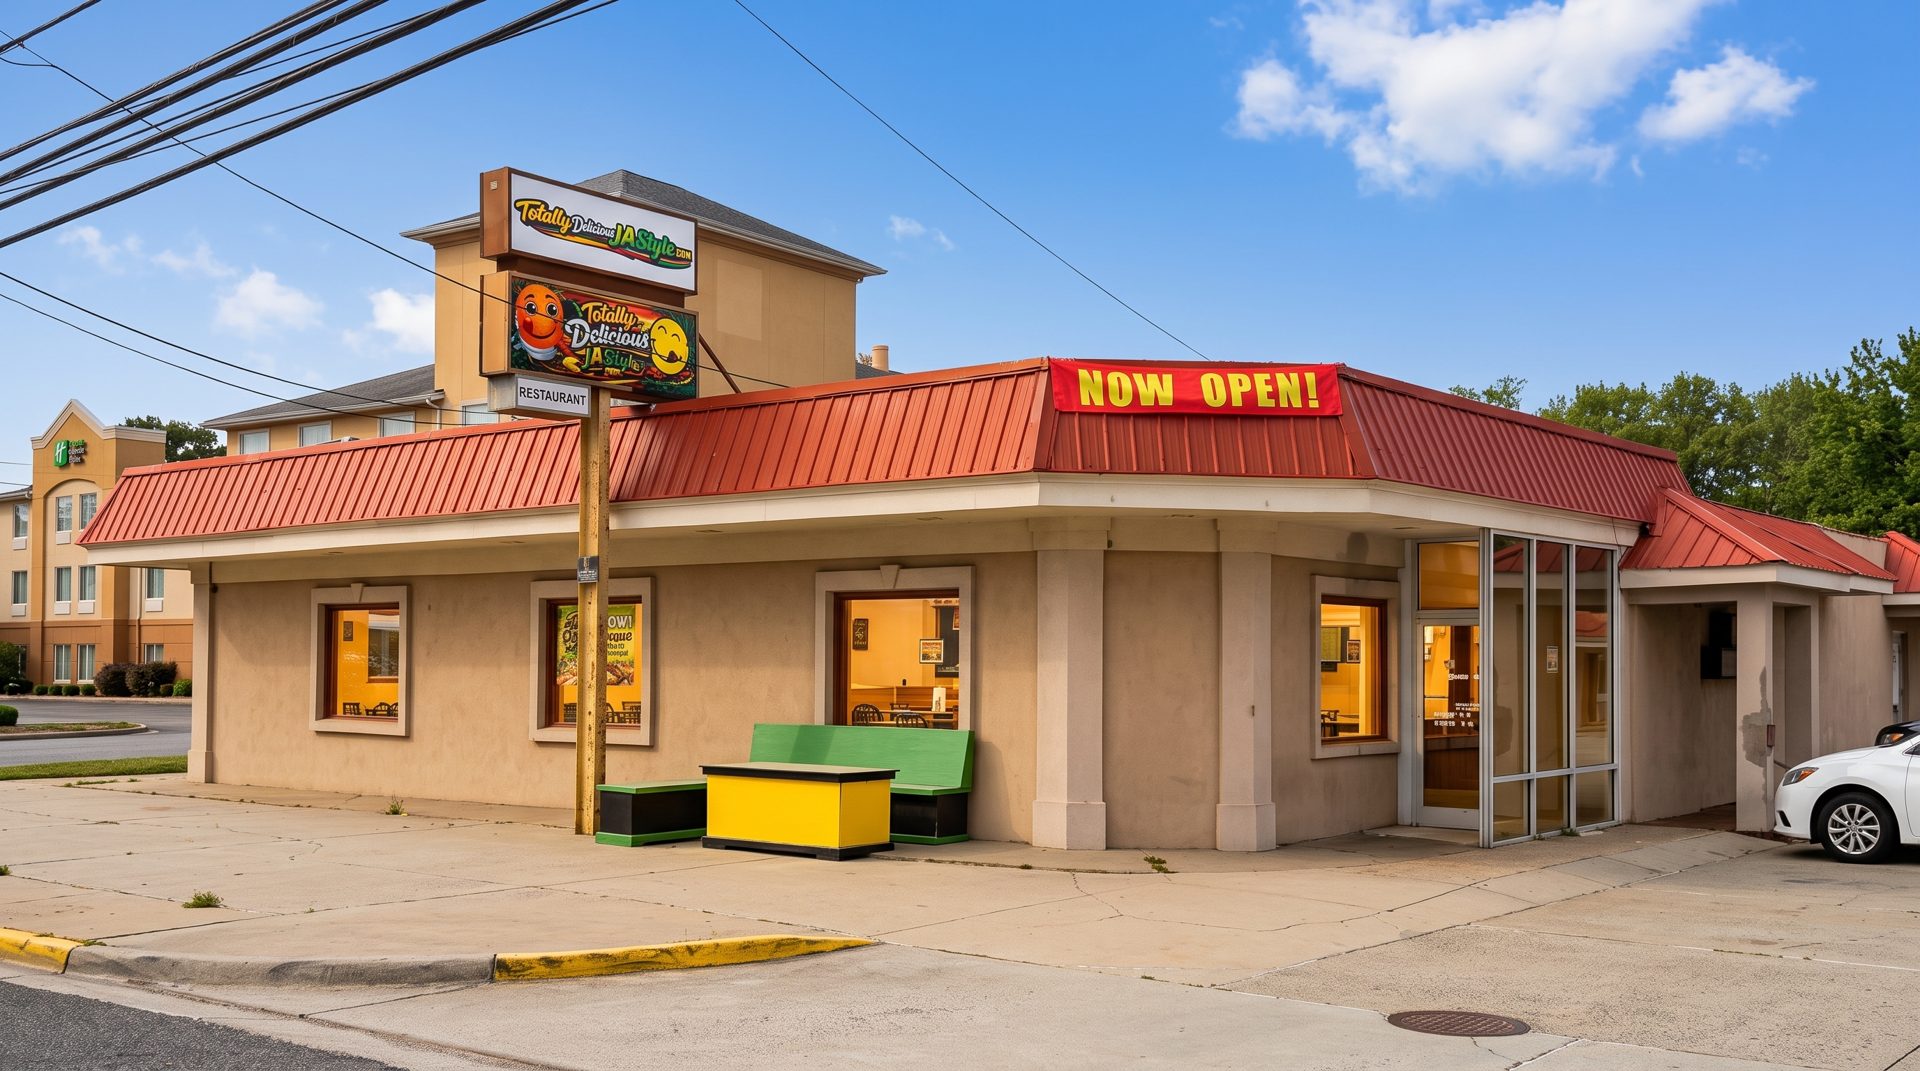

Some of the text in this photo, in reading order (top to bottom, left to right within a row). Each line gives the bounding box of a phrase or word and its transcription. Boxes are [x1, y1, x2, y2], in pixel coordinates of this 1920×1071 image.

[515, 200, 573, 234] Totally
[572, 216, 616, 238] Delicious
[581, 301, 637, 332] Totally
[564, 318, 650, 349] Delicious
[519, 386, 587, 406] RESTAURANT
[1077, 368, 1320, 408] NOW OPEN!
[607, 615, 633, 629] OW!
